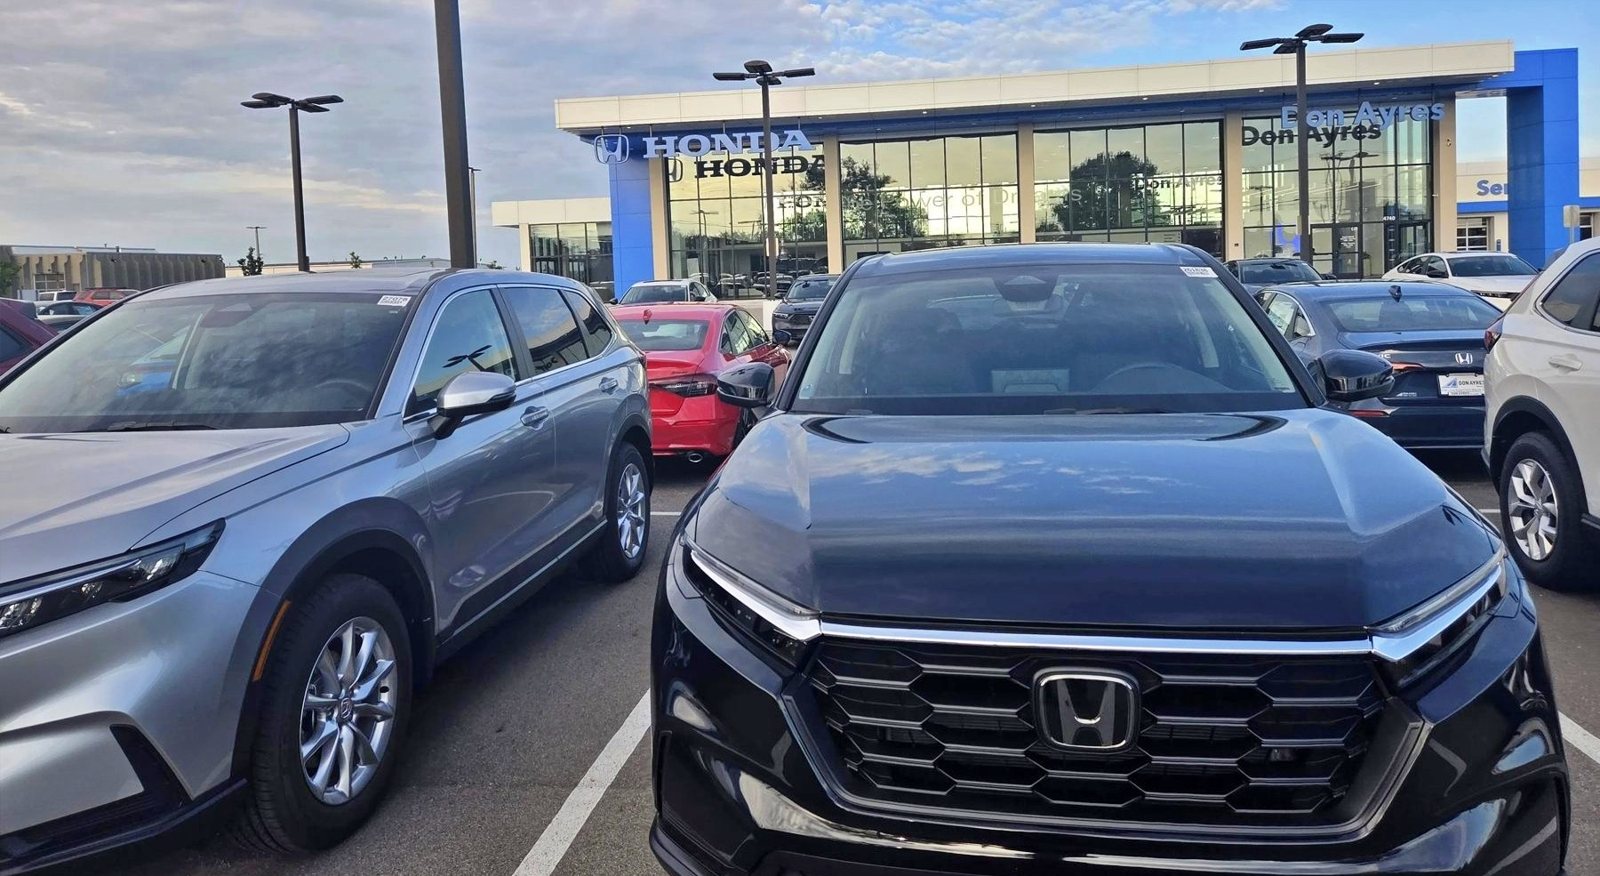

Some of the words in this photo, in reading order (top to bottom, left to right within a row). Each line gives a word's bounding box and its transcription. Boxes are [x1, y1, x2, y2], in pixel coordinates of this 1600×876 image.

[1353, 101, 1446, 130] Ayres
[643, 129, 814, 158] HONDA
[1242, 126, 1294, 146] Don
[1307, 124, 1382, 148] Ayres
